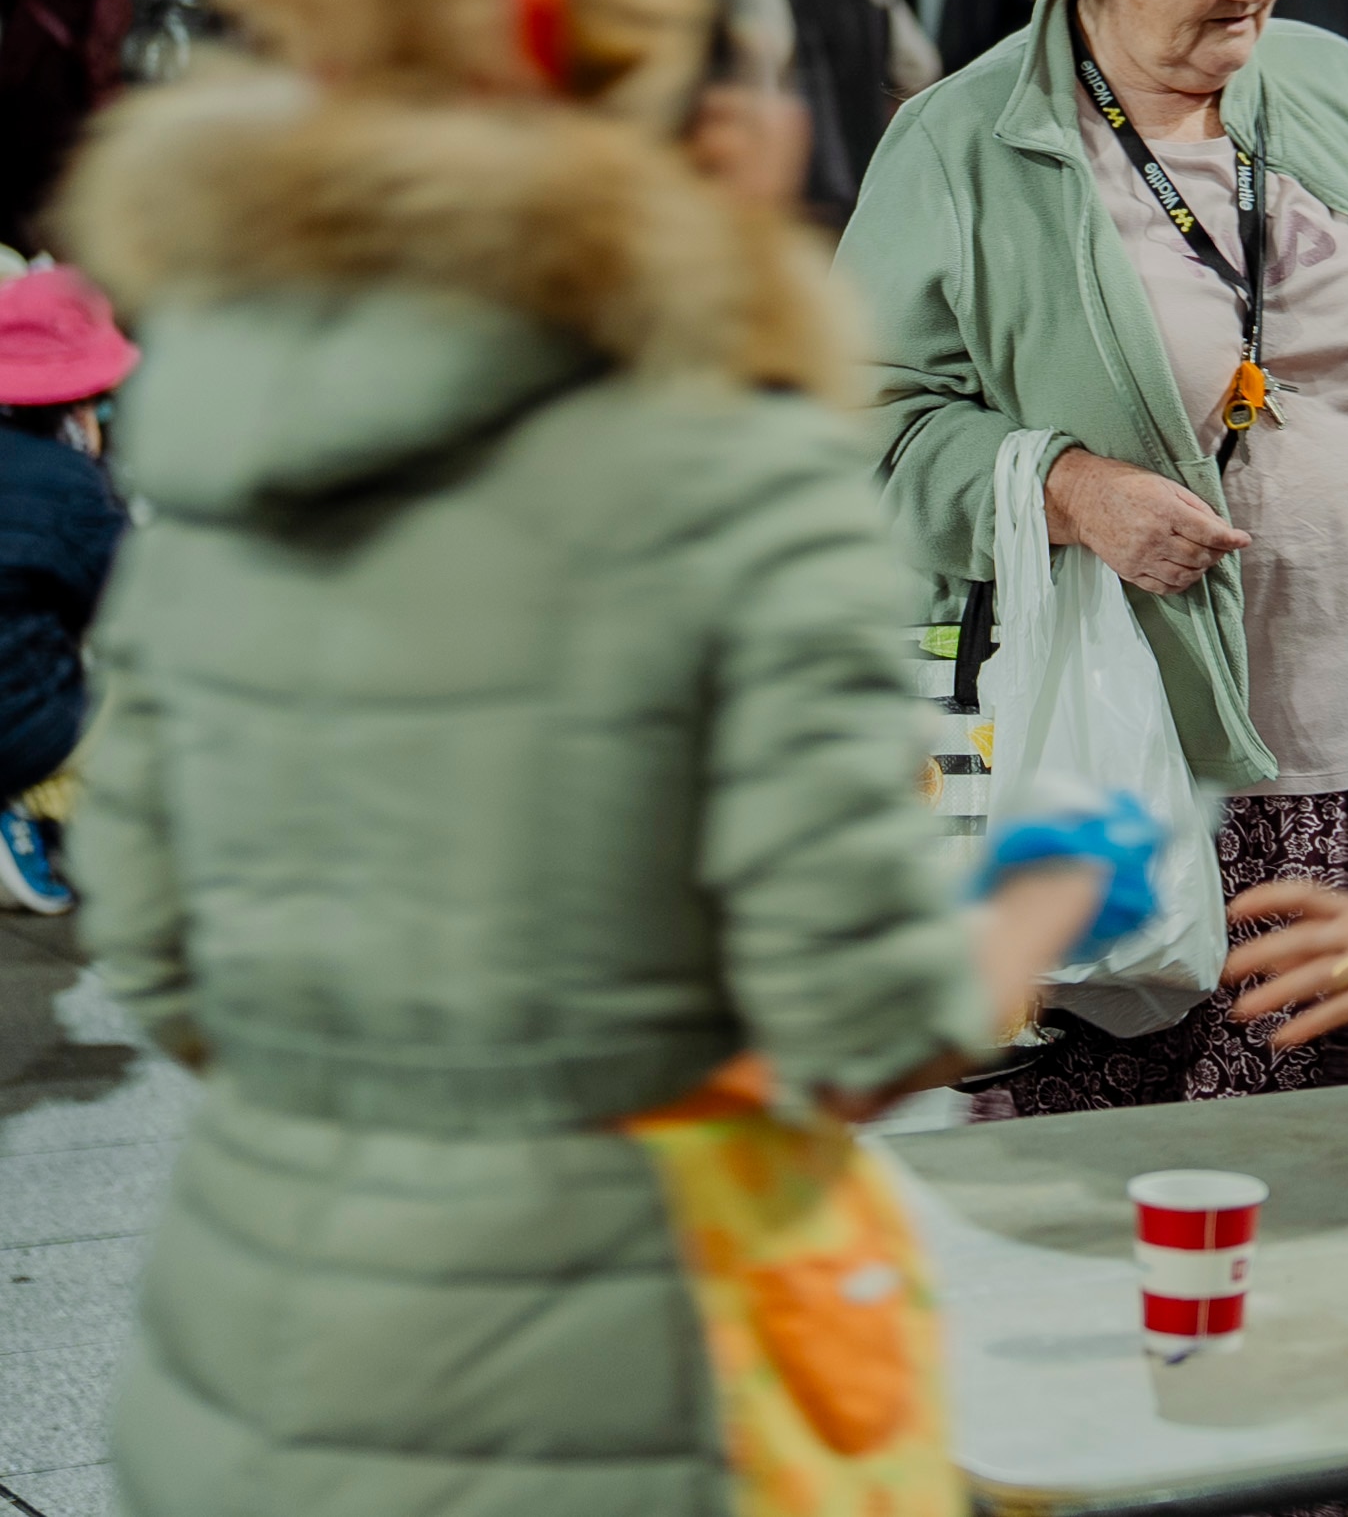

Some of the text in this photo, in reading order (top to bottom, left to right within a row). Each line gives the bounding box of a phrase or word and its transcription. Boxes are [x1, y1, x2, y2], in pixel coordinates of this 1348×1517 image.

[1080, 60, 1114, 107] Wattle
[1144, 162, 1180, 210] Wattle
[1237, 165, 1255, 211] Wattle
